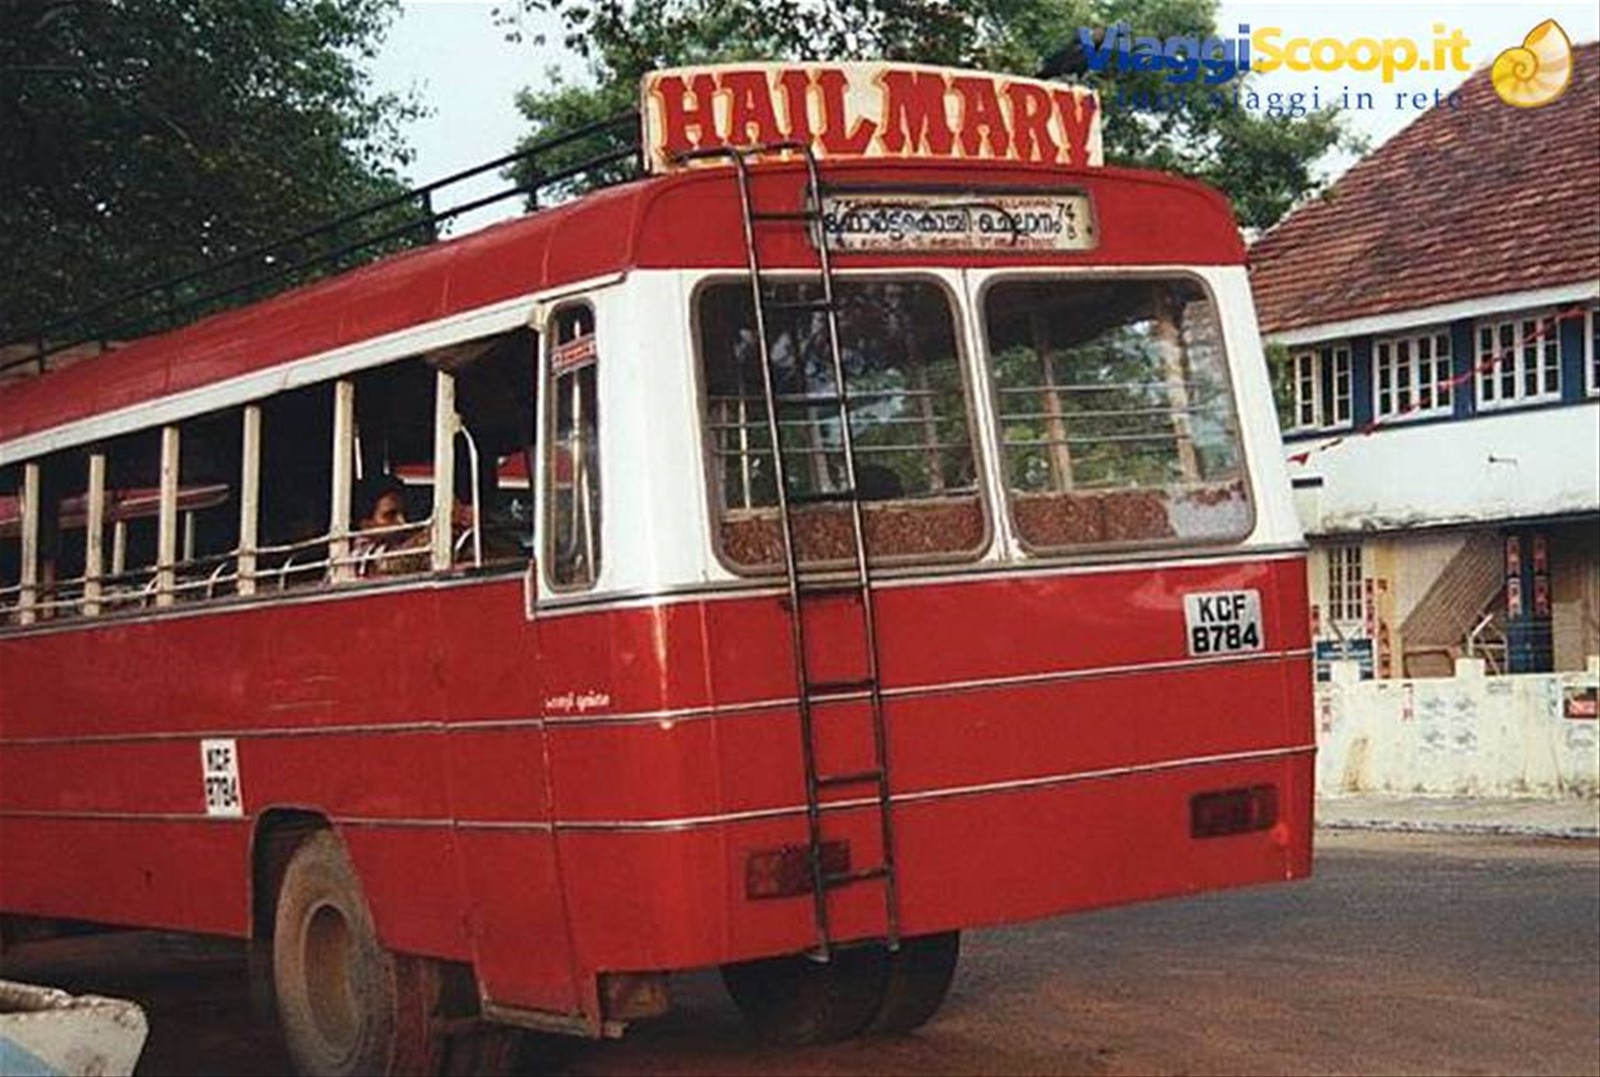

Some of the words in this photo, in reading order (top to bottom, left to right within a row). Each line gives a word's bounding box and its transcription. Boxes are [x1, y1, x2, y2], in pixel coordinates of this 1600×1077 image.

[655, 69, 878, 158] HAIL
[876, 69, 1098, 167] MARY
[1197, 594, 1246, 623] KCF
[1192, 622, 1259, 653] 8784
